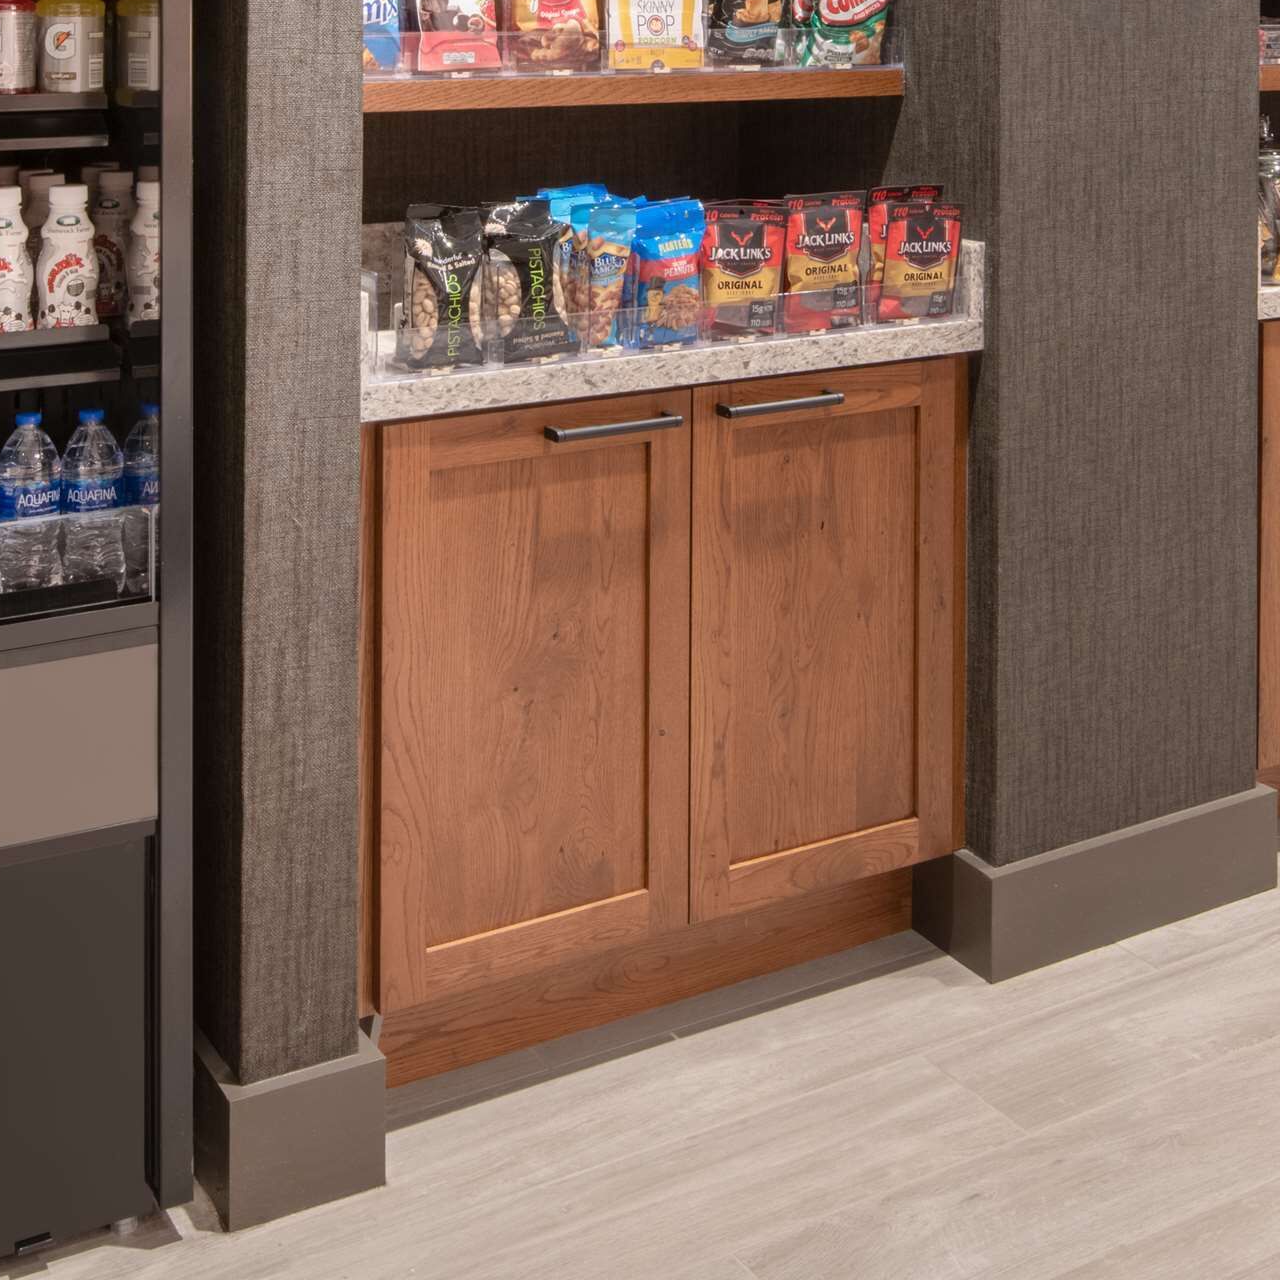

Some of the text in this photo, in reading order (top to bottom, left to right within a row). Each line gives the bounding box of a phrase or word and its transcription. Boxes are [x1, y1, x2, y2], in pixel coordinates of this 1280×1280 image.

[636, 0, 675, 14] SKINNY
[636, 14, 675, 37] POP
[44, 23, 77, 61] G
[796, 235, 826, 249] JACK
[898, 241, 923, 254] JACK
[709, 247, 739, 261] JACK
[805, 264, 849, 276] ORIGINAL
[903, 271, 944, 282] ORIGINAL
[528, 247, 546, 331] PISTACHIOS
[717, 280, 764, 290] ORIGINAL
[447, 273, 462, 357] PISTACHIOS
[67, 486, 117, 505] AQUAFINA
